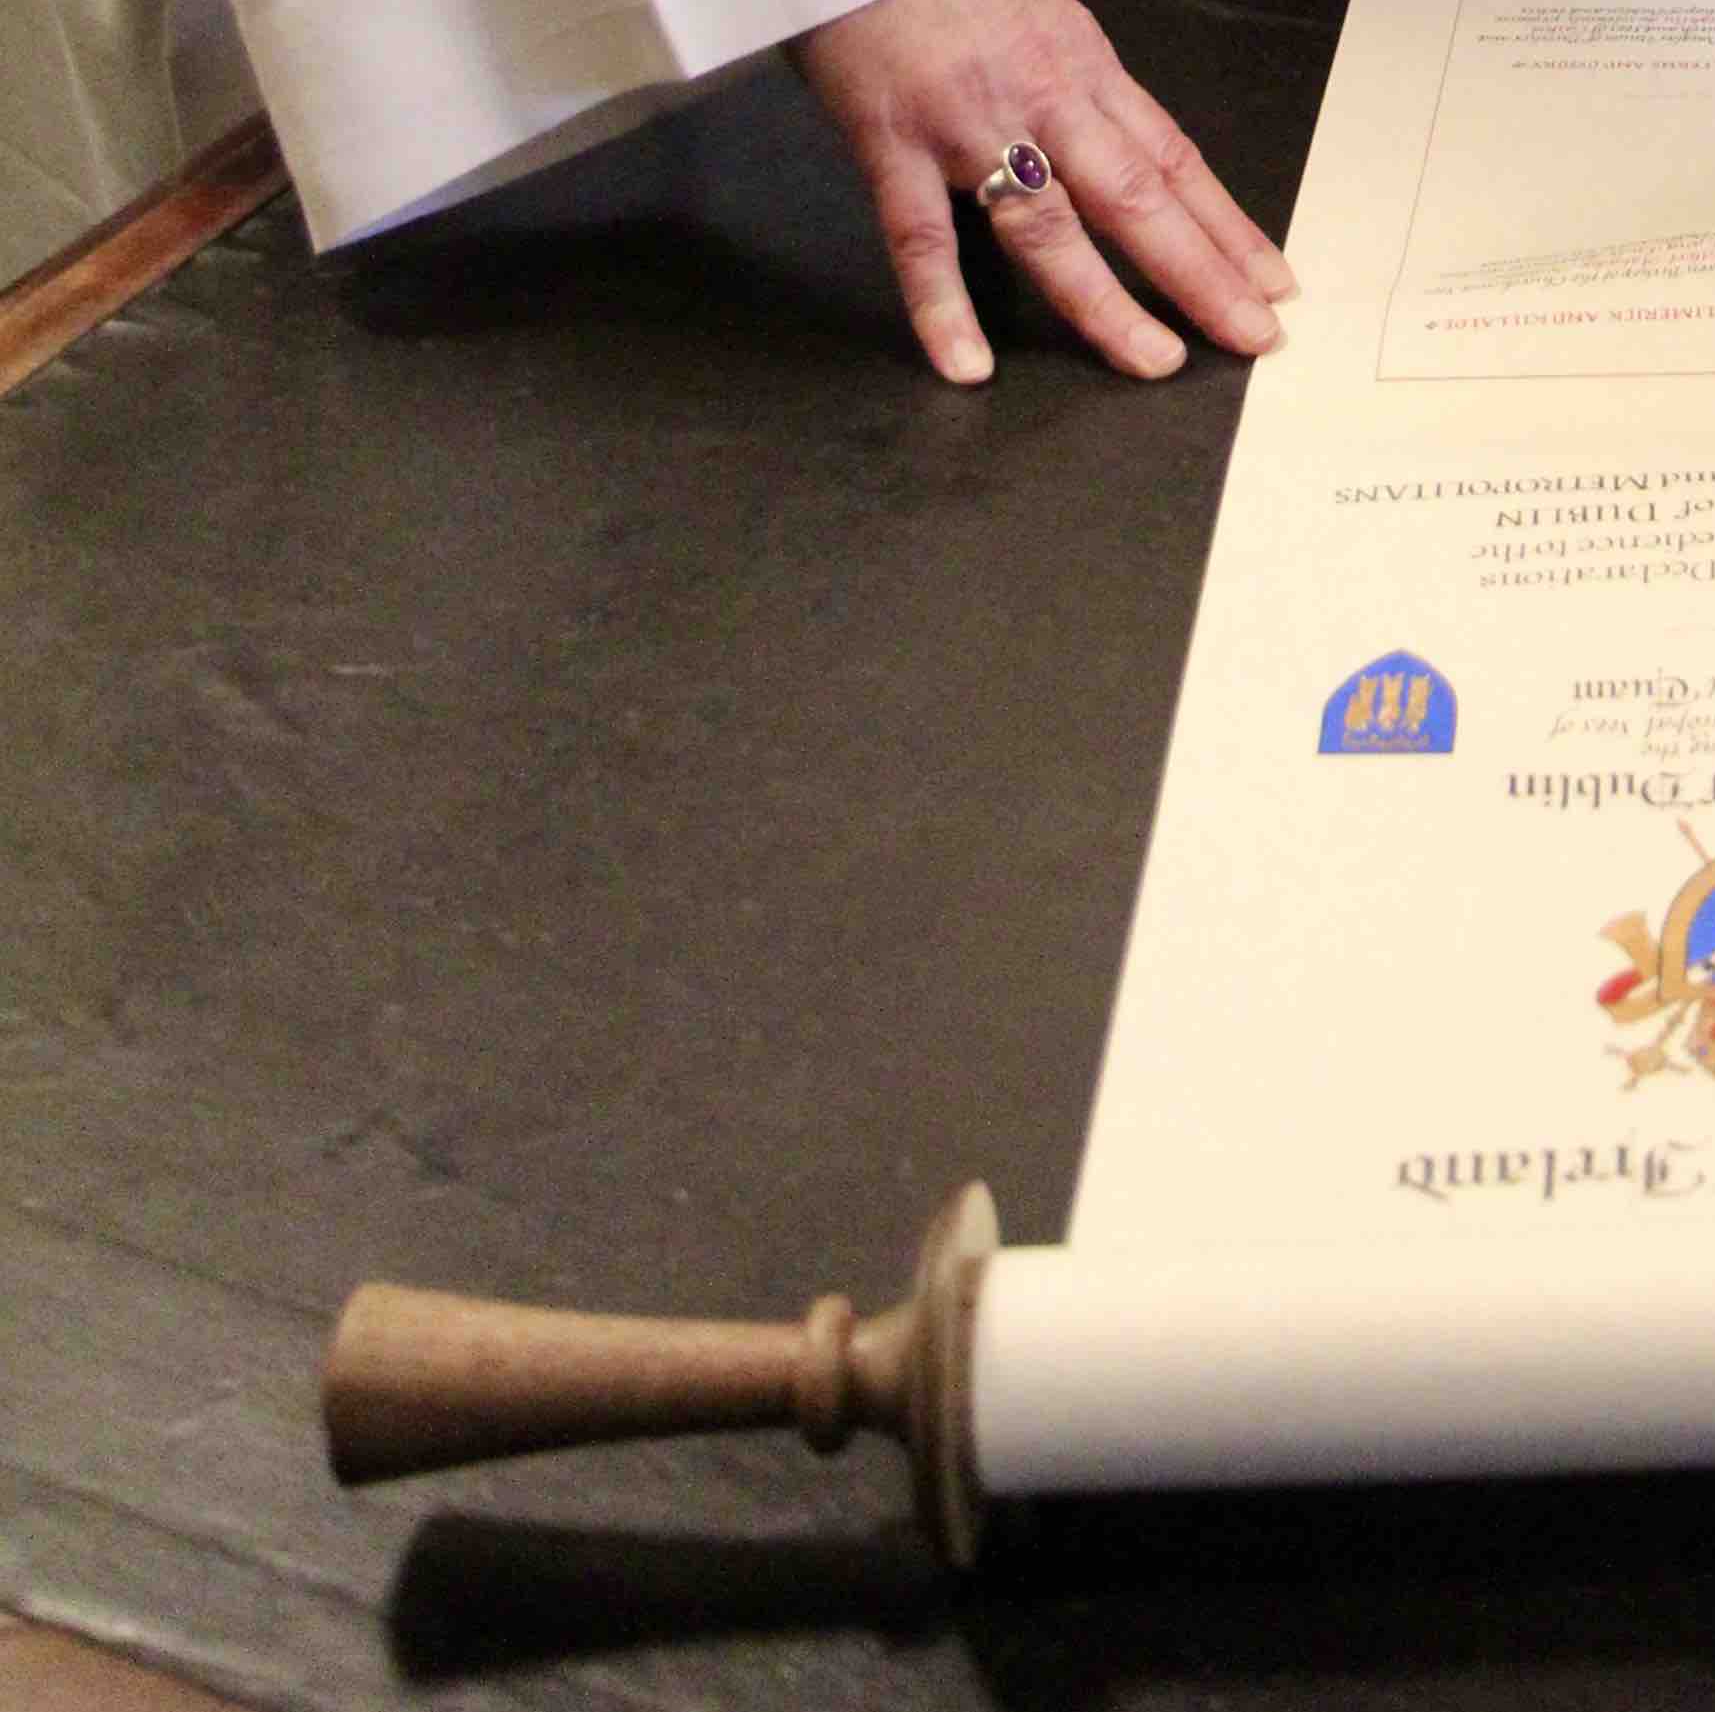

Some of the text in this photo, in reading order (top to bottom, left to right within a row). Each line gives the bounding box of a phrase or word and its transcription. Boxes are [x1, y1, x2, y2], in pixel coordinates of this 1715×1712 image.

[1553, 310, 1599, 325] AND
[1334, 470, 1651, 506] METROPOLITANS
[1495, 500, 1658, 528] DUBLIN
[1672, 499, 1715, 521] of
[1471, 542, 1531, 566] the
[1571, 674, 1699, 709] Tuam
[1547, 714, 1576, 741] of
[1639, 742, 1680, 762] the
[1505, 771, 1694, 811] Dublin
[1397, 1140, 1701, 1201] Ireland
